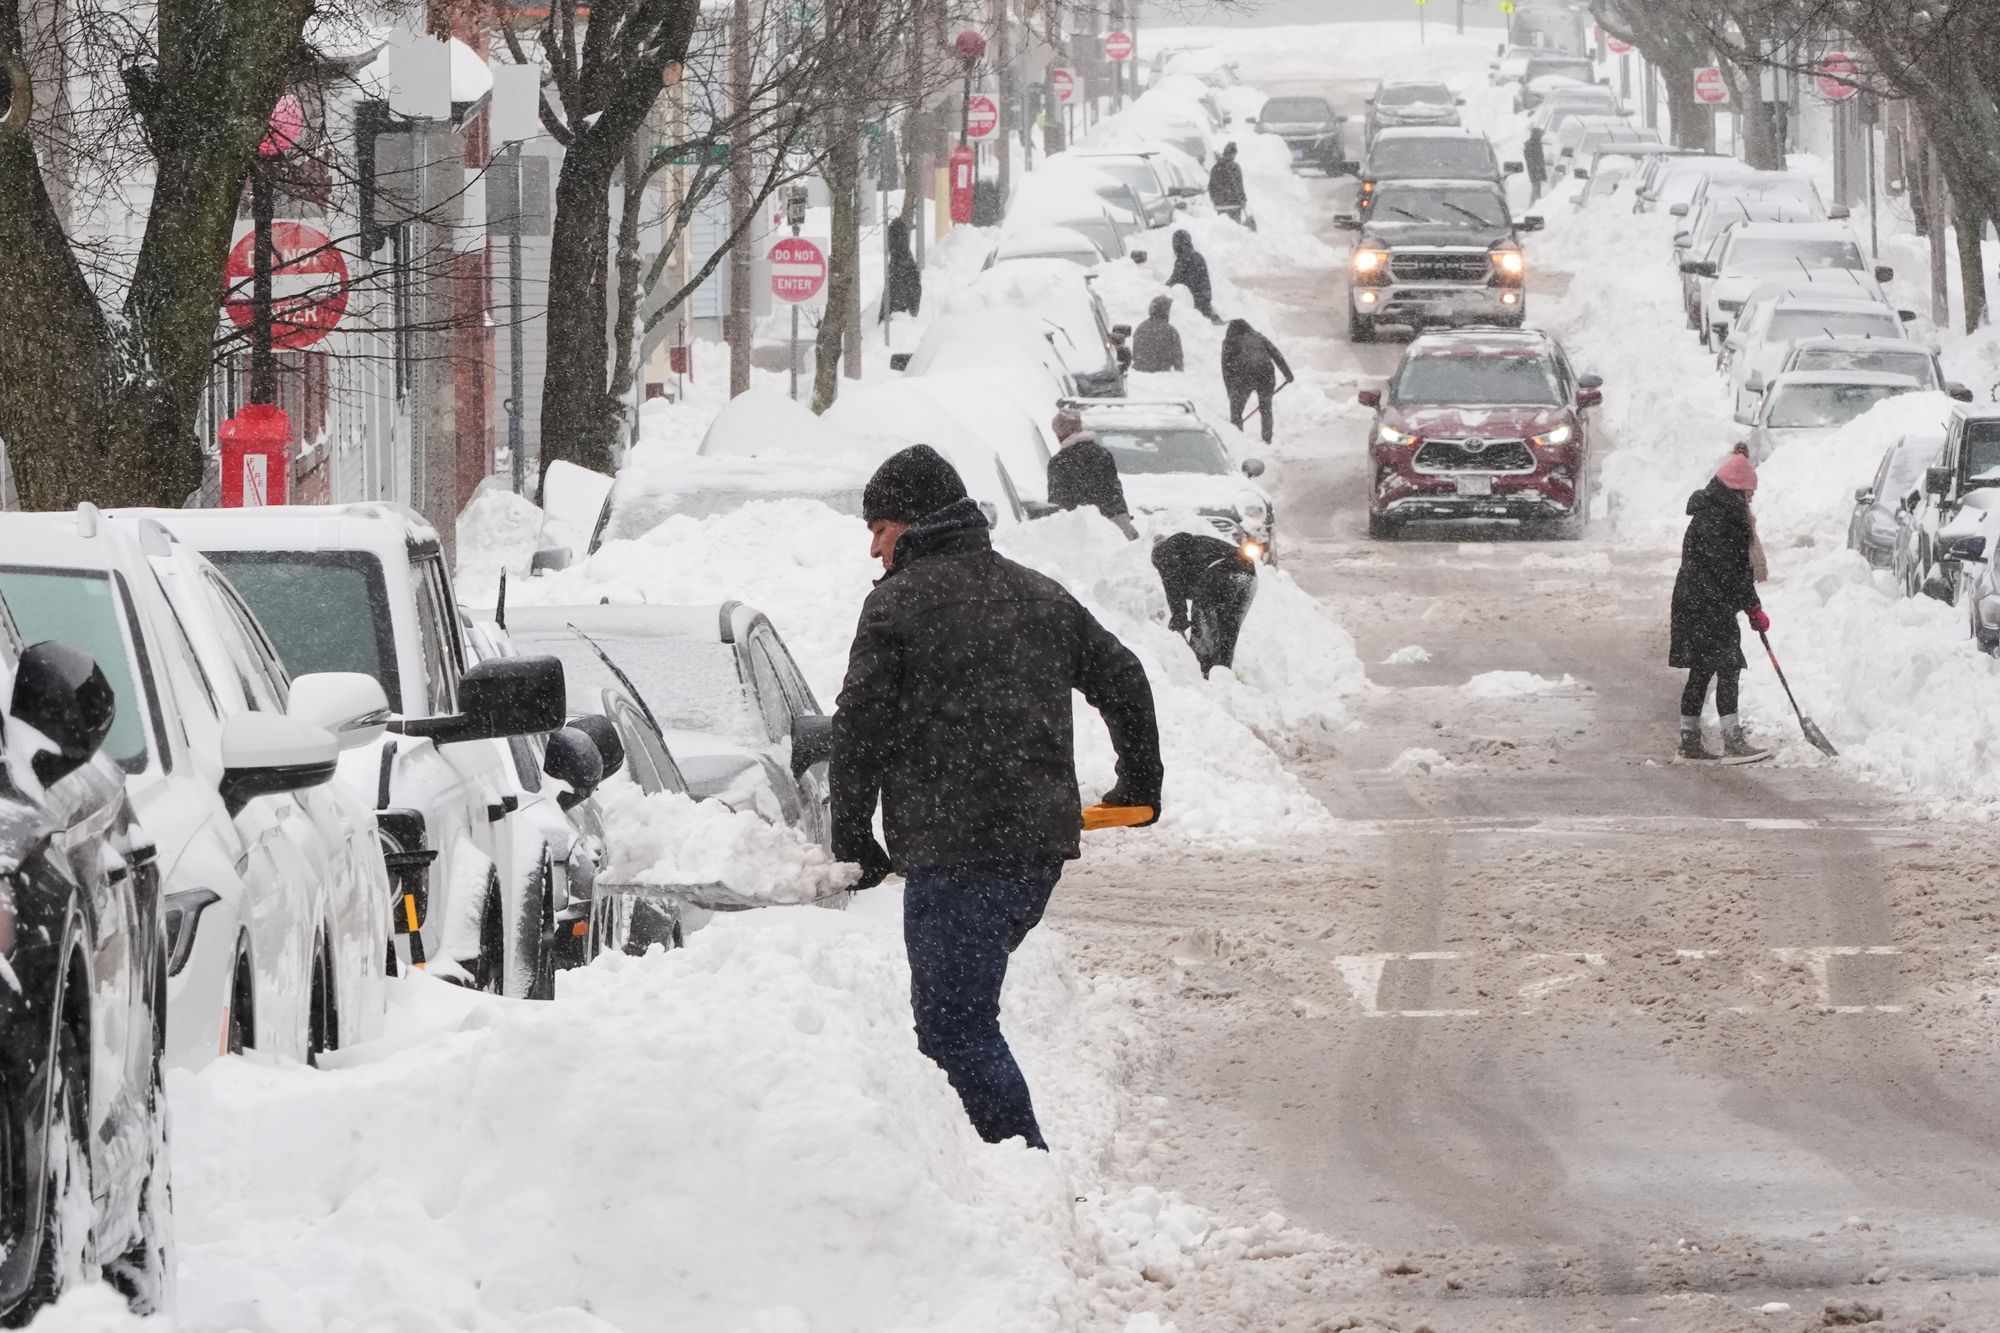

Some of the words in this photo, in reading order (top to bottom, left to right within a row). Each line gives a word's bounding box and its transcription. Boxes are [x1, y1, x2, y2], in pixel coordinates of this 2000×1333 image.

[775, 249, 790, 260] DO
[794, 250, 815, 261] NOT
[1419, 262, 1460, 270] RAM
[777, 279, 812, 290] ENTER
[249, 457, 264, 487] FIRE
